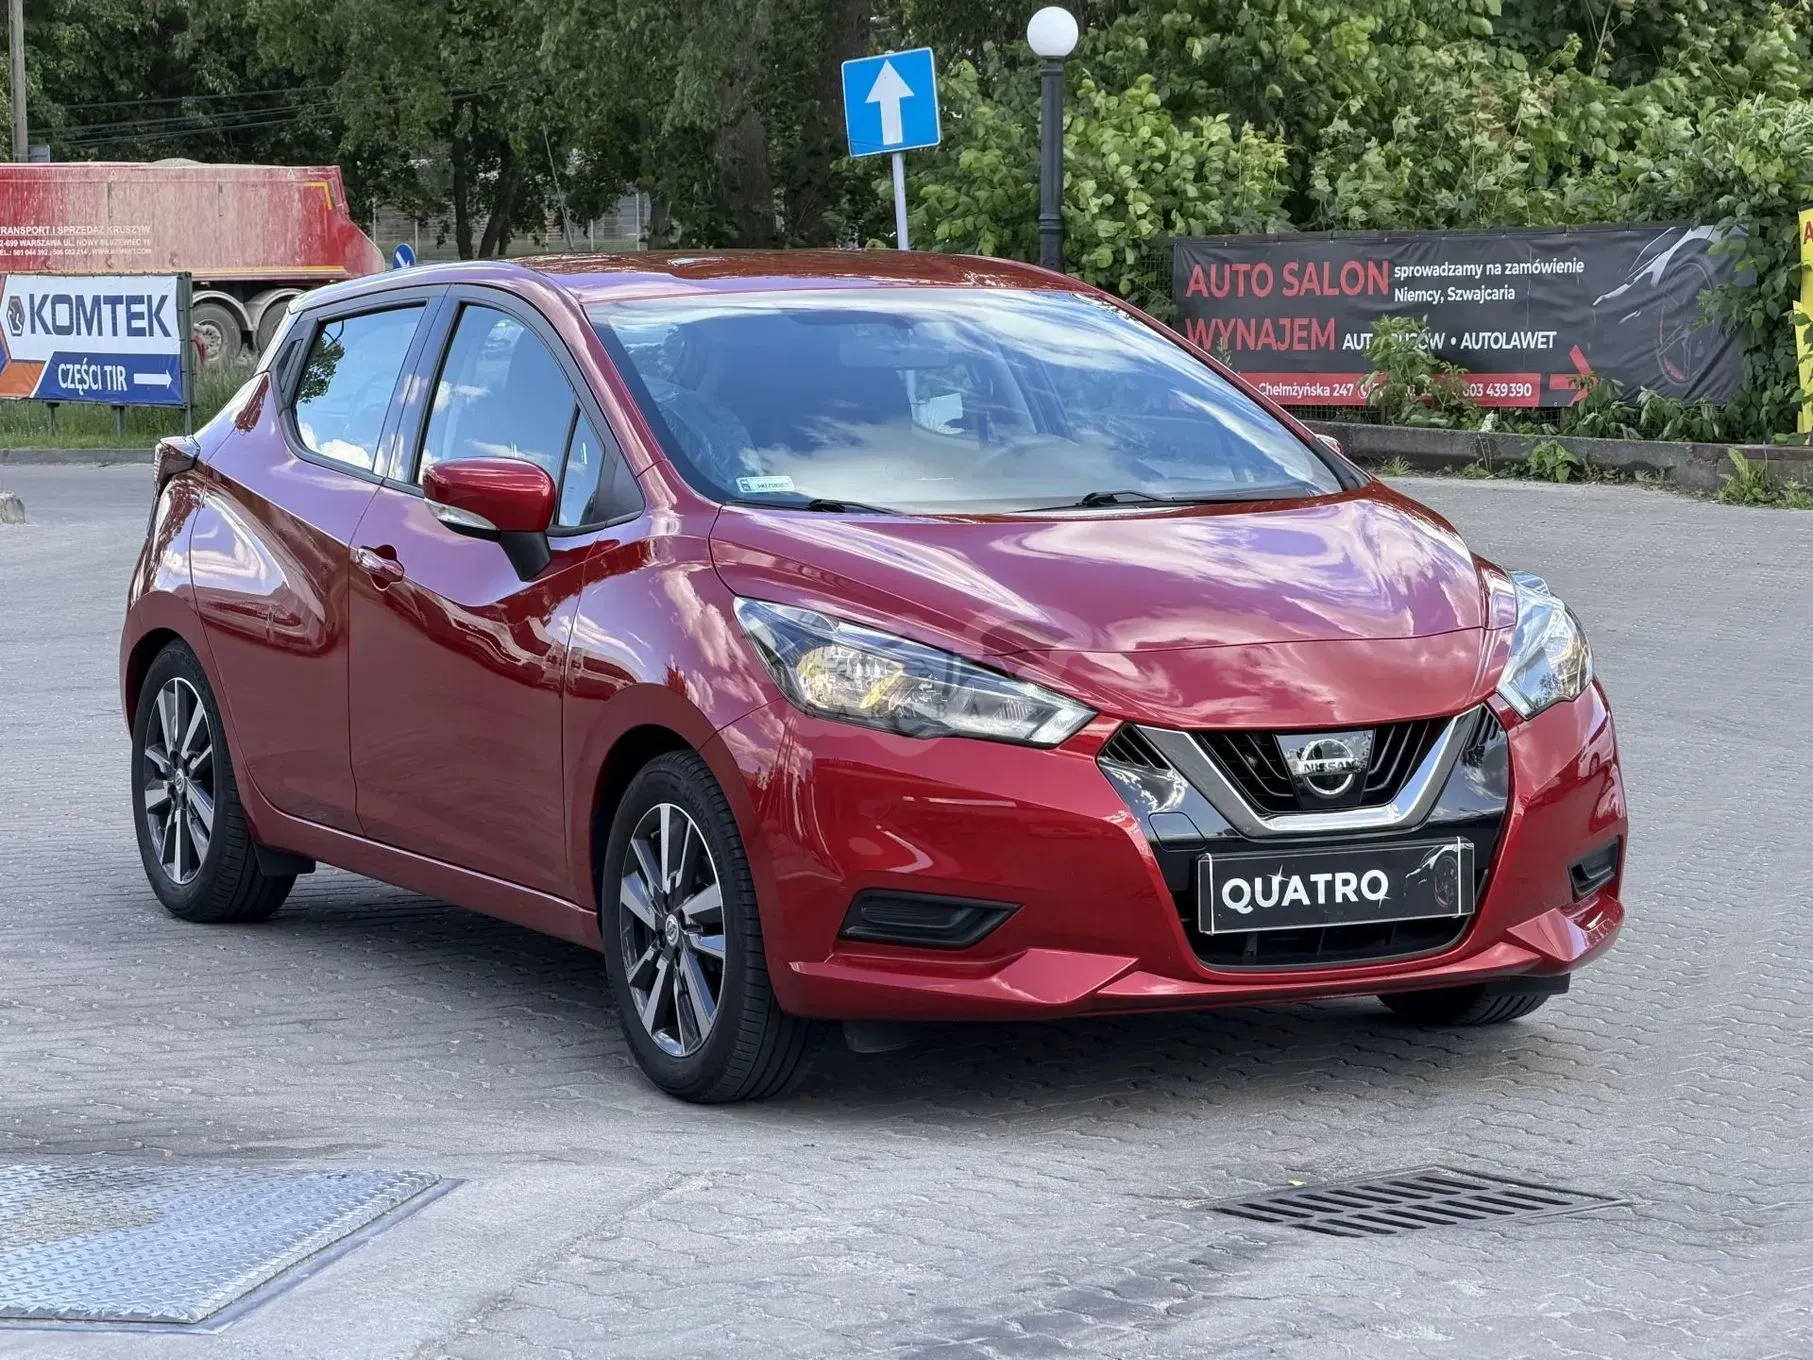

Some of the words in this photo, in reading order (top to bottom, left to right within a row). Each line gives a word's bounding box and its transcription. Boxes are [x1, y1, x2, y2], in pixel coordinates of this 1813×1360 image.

[0, 225, 51, 235] RANSPORT
[19, 239, 62, 247] WARSZAWA
[1185, 262, 1275, 298] AUTO
[1282, 259, 1390, 297] SALON
[1393, 261, 1484, 281] sprowadzamy
[1486, 266, 1502, 276] na
[1504, 257, 1585, 275] zamówienie
[1394, 286, 1444, 304] Niemcy,
[1447, 284, 1516, 304] Szwajcaria
[29, 293, 172, 338] KOMTEK
[1185, 316, 1336, 351] WYNAJEM
[1460, 331, 1557, 350] AUTOLAWET
[57, 357, 102, 396] CZĘŚCI
[104, 365, 128, 392] TIR
[1258, 382, 1331, 399] Chełmżyńska
[1332, 383, 1354, 397] 247
[1303, 759, 1356, 773] NISSAN
[1221, 869, 1389, 914] QUATRO
